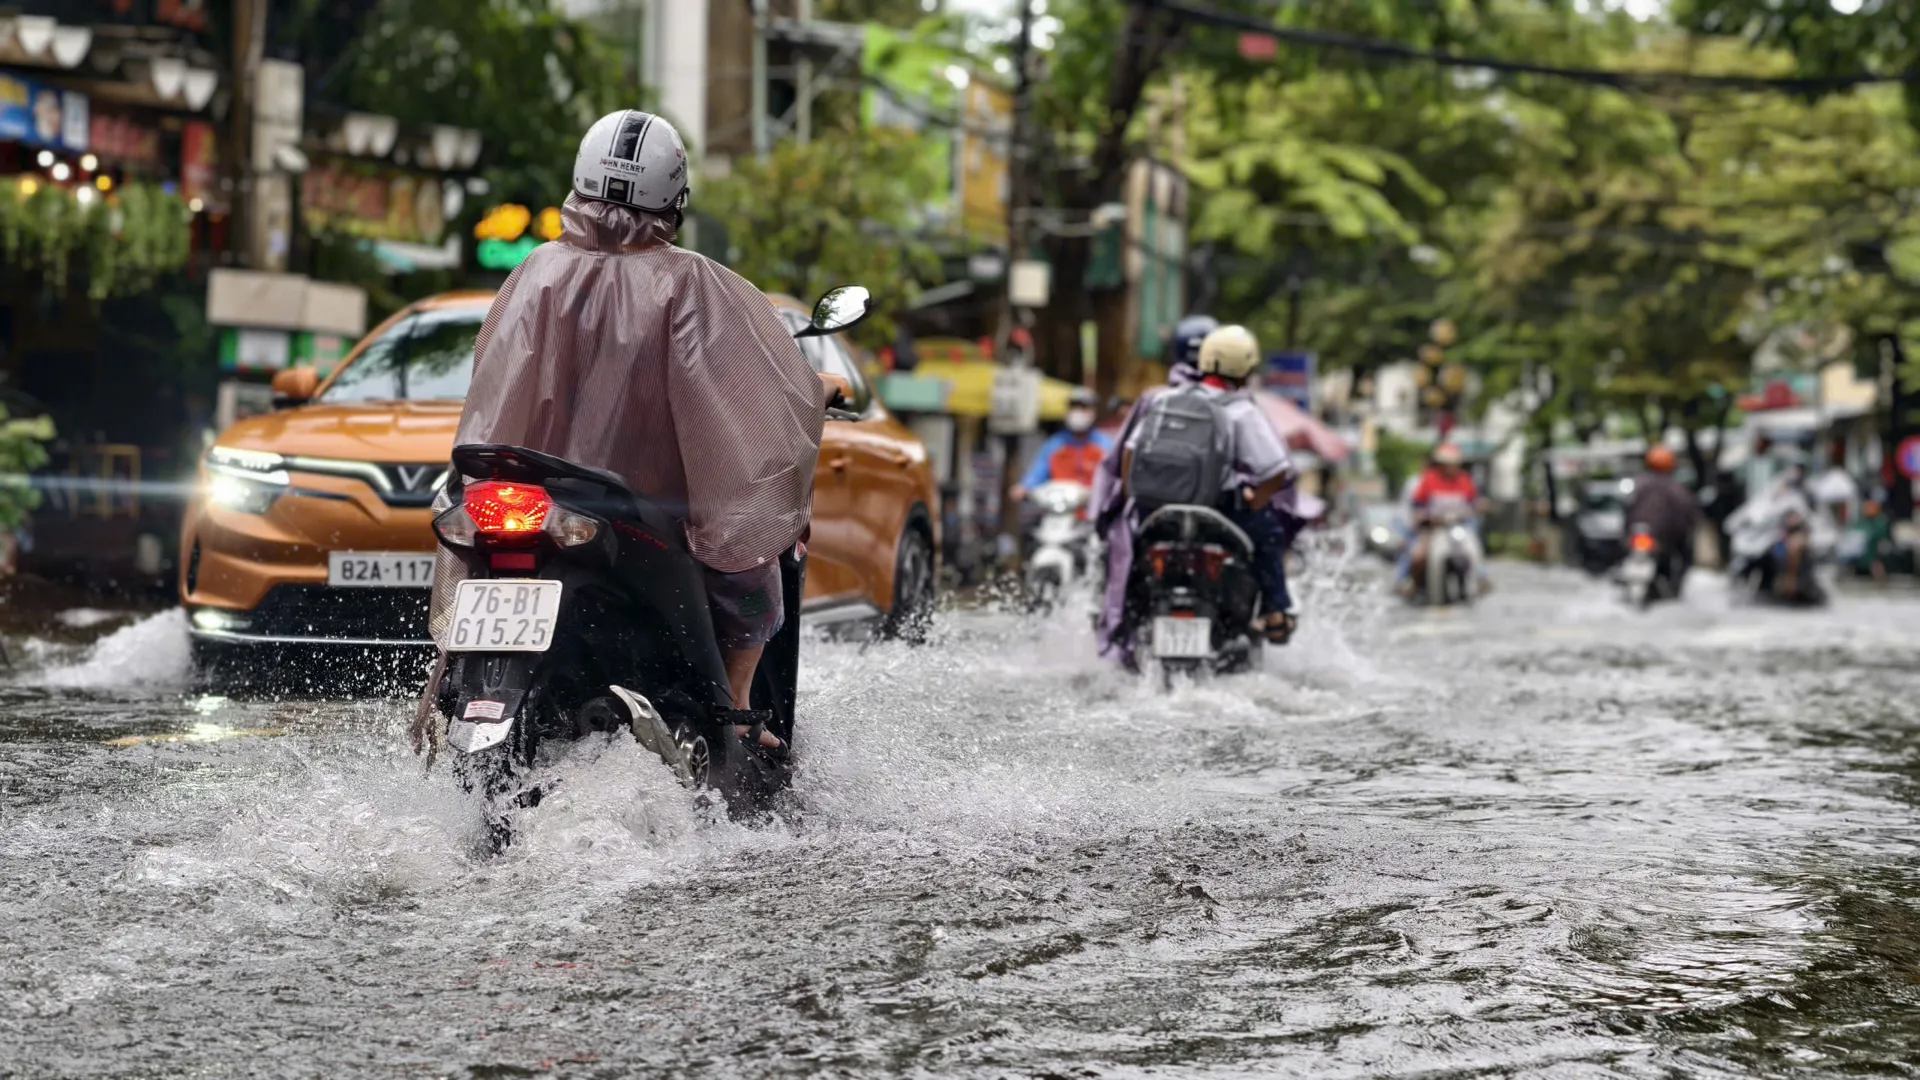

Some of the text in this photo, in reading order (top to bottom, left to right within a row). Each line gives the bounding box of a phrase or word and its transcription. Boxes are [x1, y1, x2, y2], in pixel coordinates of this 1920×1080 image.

[600, 158, 618, 168] JOHN
[620, 161, 646, 174] HENRY
[470, 586, 542, 615] 76-B1
[454, 618, 549, 646] 615.25
